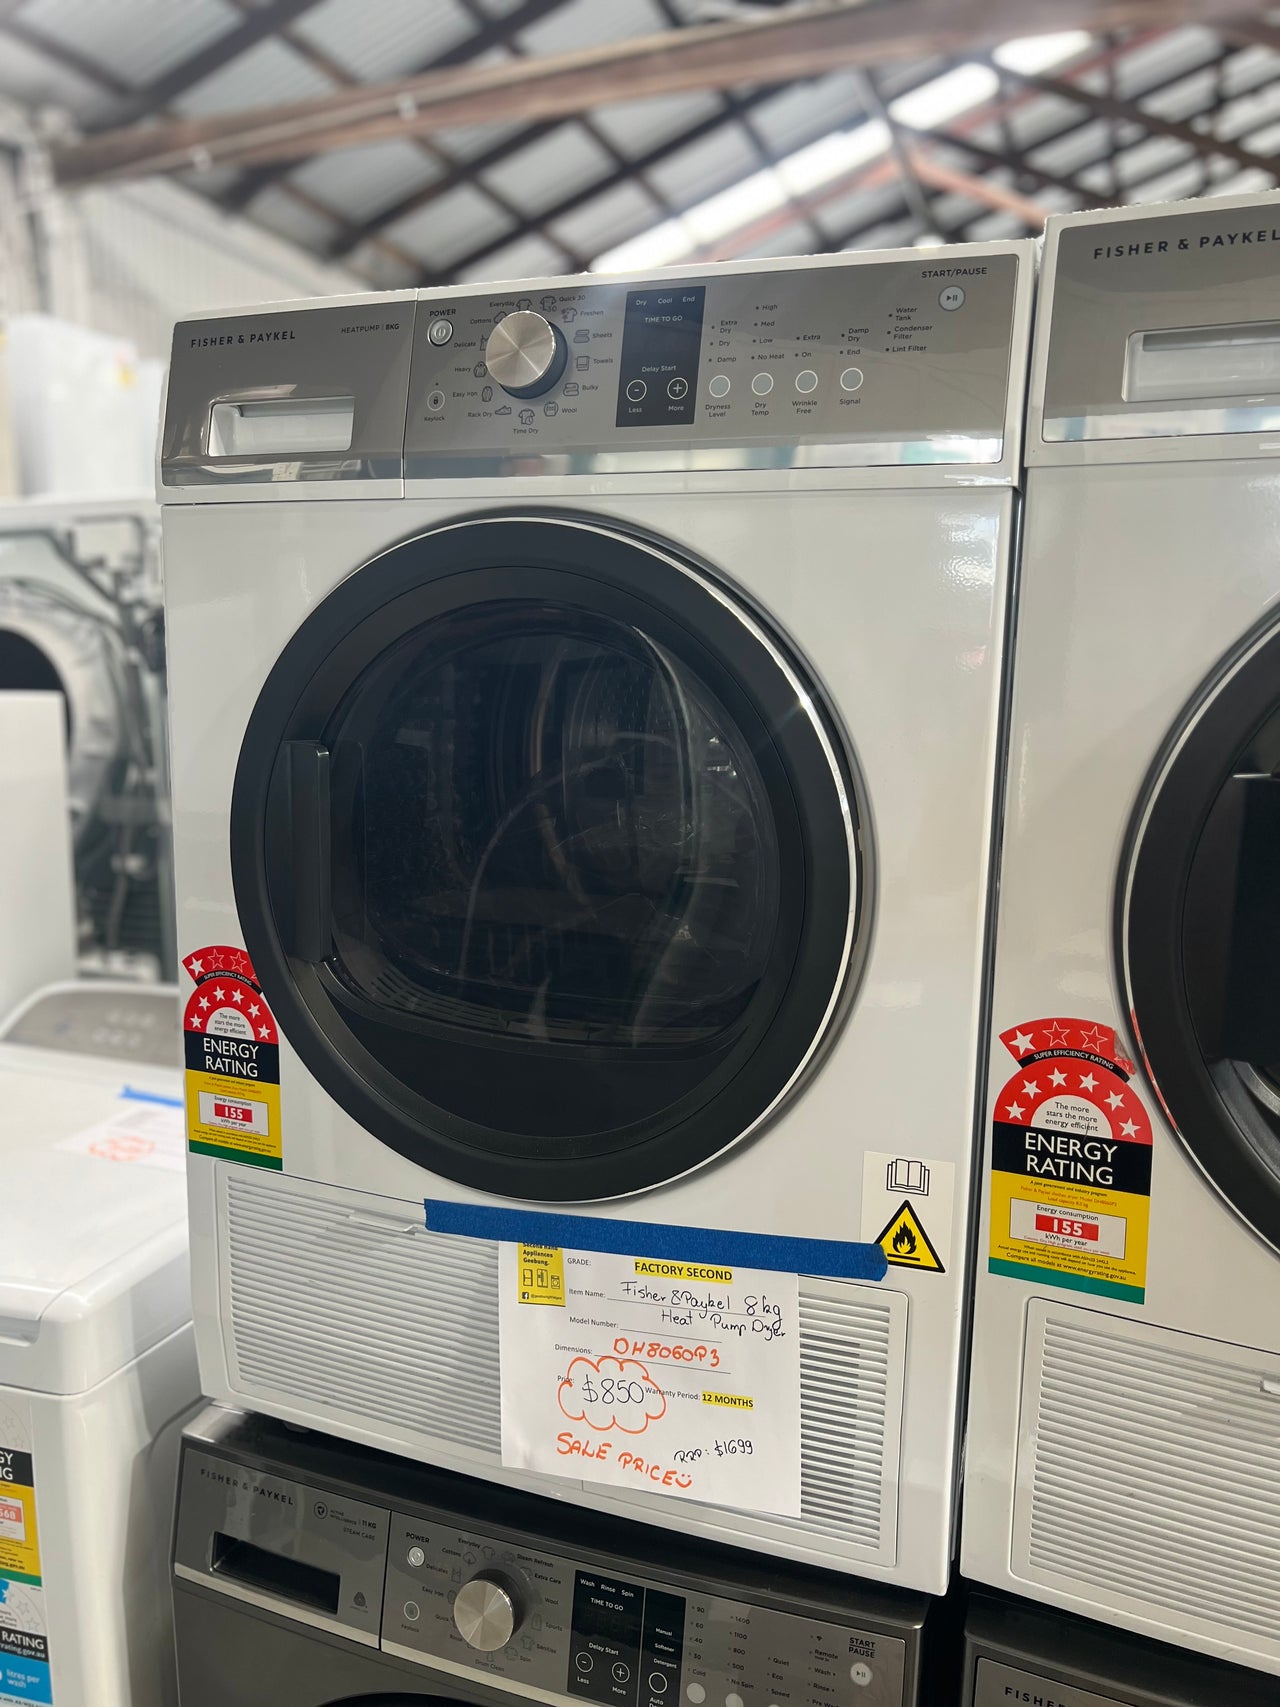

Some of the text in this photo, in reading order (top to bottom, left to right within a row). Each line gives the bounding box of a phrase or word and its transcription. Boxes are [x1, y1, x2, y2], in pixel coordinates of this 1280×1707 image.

[1094, 229, 1280, 259] FISHER & PAYKEL
[921, 267, 988, 278] START/PAUSE
[429, 308, 456, 317] POWER
[762, 304, 778, 312] High
[341, 322, 400, 334] HEATPUMP 8KG
[848, 327, 869, 336] Damp
[894, 324, 932, 332] Condenser
[191, 330, 296, 348] FISHER & PAYKEL
[717, 356, 736, 364] Damp
[642, 365, 659, 373] Delay
[705, 403, 731, 411] Dryness
[792, 400, 818, 408] Wrinkle
[203, 1038, 259, 1059] ENERGY
[1033, 1050, 1114, 1070] SUPER EFFICIENCY RATING
[205, 1055, 258, 1077] RATING
[1055, 1102, 1068, 1110] The
[225, 1106, 243, 1119] 155
[1046, 1110, 1063, 1118] stars
[1065, 1112, 1076, 1120] the
[1045, 1119, 1098, 1132] energy efficient
[1025, 1132, 1118, 1162] ENERGY
[1026, 1154, 1113, 1185] RATING
[1036, 1205, 1098, 1221] Energy consumption
[1053, 1219, 1083, 1236] 155
[1045, 1234, 1060, 1242] kWh
[523, 1250, 553, 1258] Appliances
[567, 1258, 591, 1266] GRADE:
[1007, 1252, 1029, 1262] Compare
[1037, 1258, 1055, 1267] models
[1063, 1264, 1126, 1280] www.energyrating.gov.au
[635, 1262, 732, 1281] FACTORY SECOND
[587, 1290, 606, 1298] Name:
[620, 1281, 666, 1301] Fisher
[570, 1317, 619, 1328] Model Number:
[662, 1309, 785, 1340] Heat Pump Dryer
[554, 1344, 592, 1354] Dimensions:
[582, 1374, 644, 1404] $850
[645, 1386, 700, 1400] Warranty Period:
[702, 1393, 753, 1408] 12 MONTHS
[714, 1439, 753, 1457] $1699
[557, 1432, 677, 1486] SALE PRICE
[201, 1469, 237, 1487] FISHER
[253, 1486, 293, 1505] PAYKEL
[406, 1532, 430, 1543] POWER
[580, 1578, 595, 1587] Wash
[601, 1584, 616, 1593] Rinse
[591, 1597, 604, 1606] TIME
[656, 1628, 672, 1636] Manual
[734, 1632, 748, 1640] 1100
[2, 1630, 44, 1650] RATING
[850, 1637, 875, 1648] START
[589, 1642, 619, 1655] Delay Start
[654, 1642, 674, 1652] Softener
[849, 1647, 875, 1658] PAUSE
[814, 1649, 838, 1659] Remote
[653, 1658, 677, 1669] Detergent
[773, 1658, 790, 1666] Quiet
[577, 1676, 589, 1685] Less
[612, 1686, 626, 1695] More
[650, 1696, 664, 1705] Auto
[1005, 1686, 1065, 1707] FISHE
